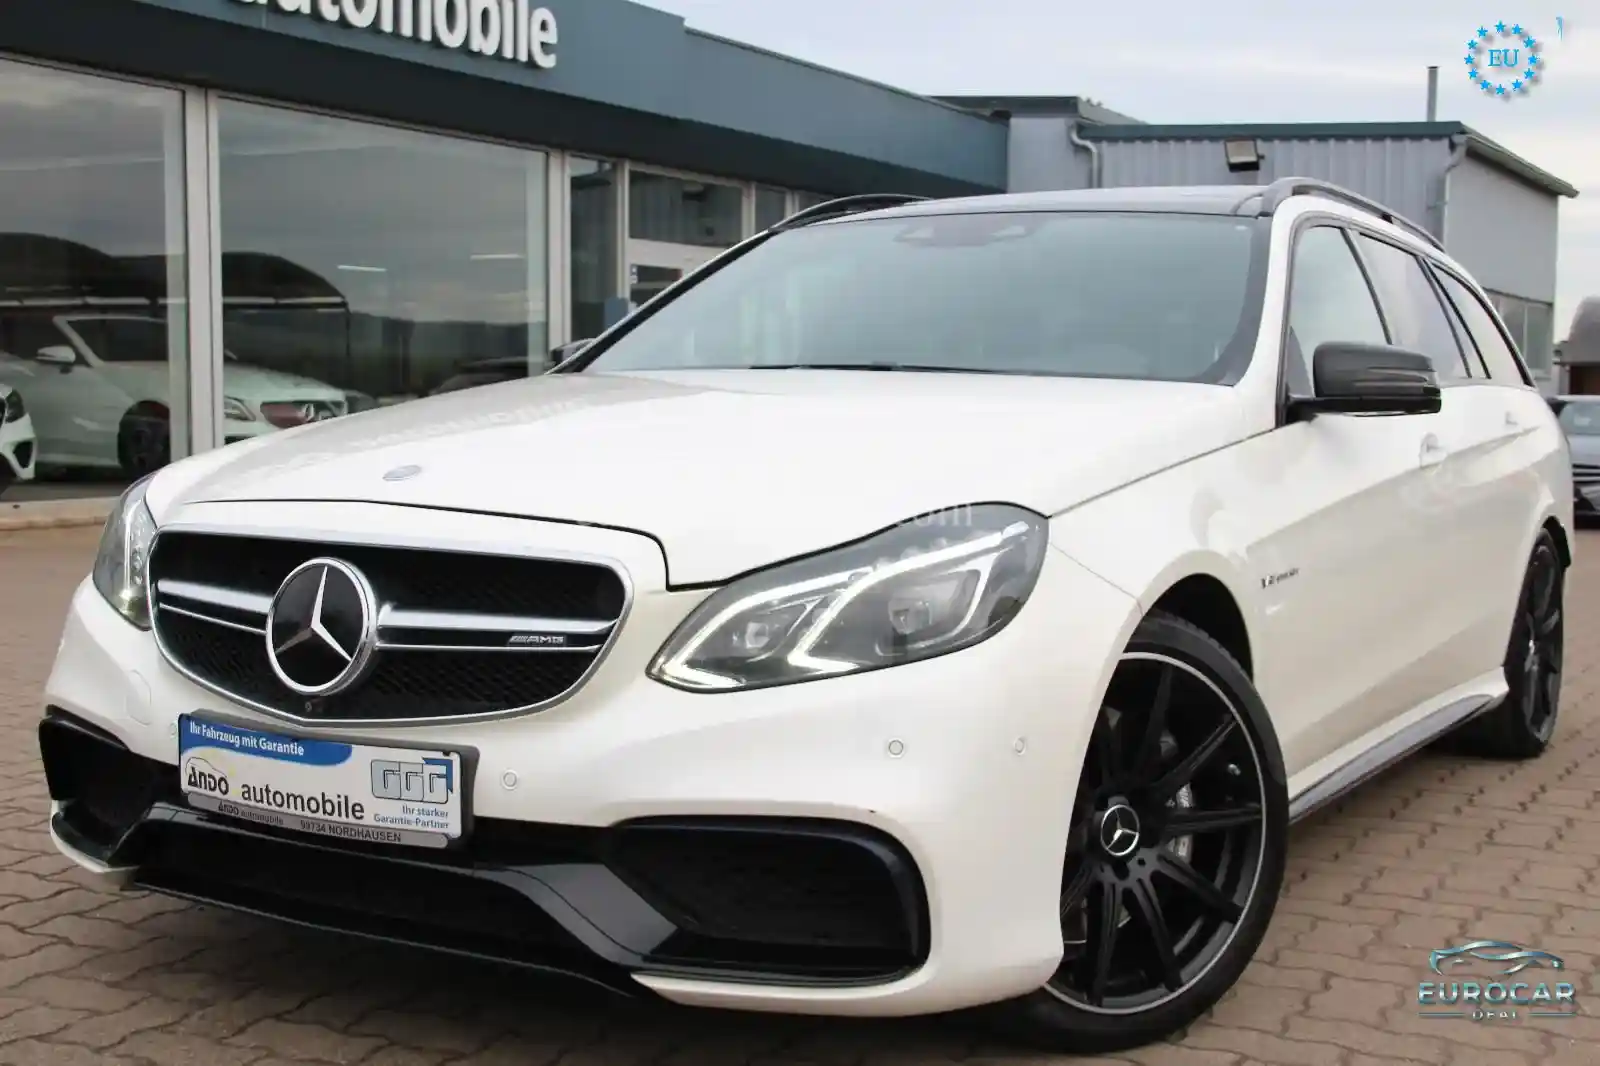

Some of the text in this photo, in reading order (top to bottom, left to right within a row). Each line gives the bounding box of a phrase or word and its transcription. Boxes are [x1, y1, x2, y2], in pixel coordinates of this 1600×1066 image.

[189, 720, 305, 757] Ihr Fahrzeug mit Garantie
[240, 783, 365, 821] automobile
[402, 803, 449, 818] Ihr starker
[300, 819, 401, 842] 99734 NORDHAUSEN
[373, 813, 449, 829] Garantie-Partner
